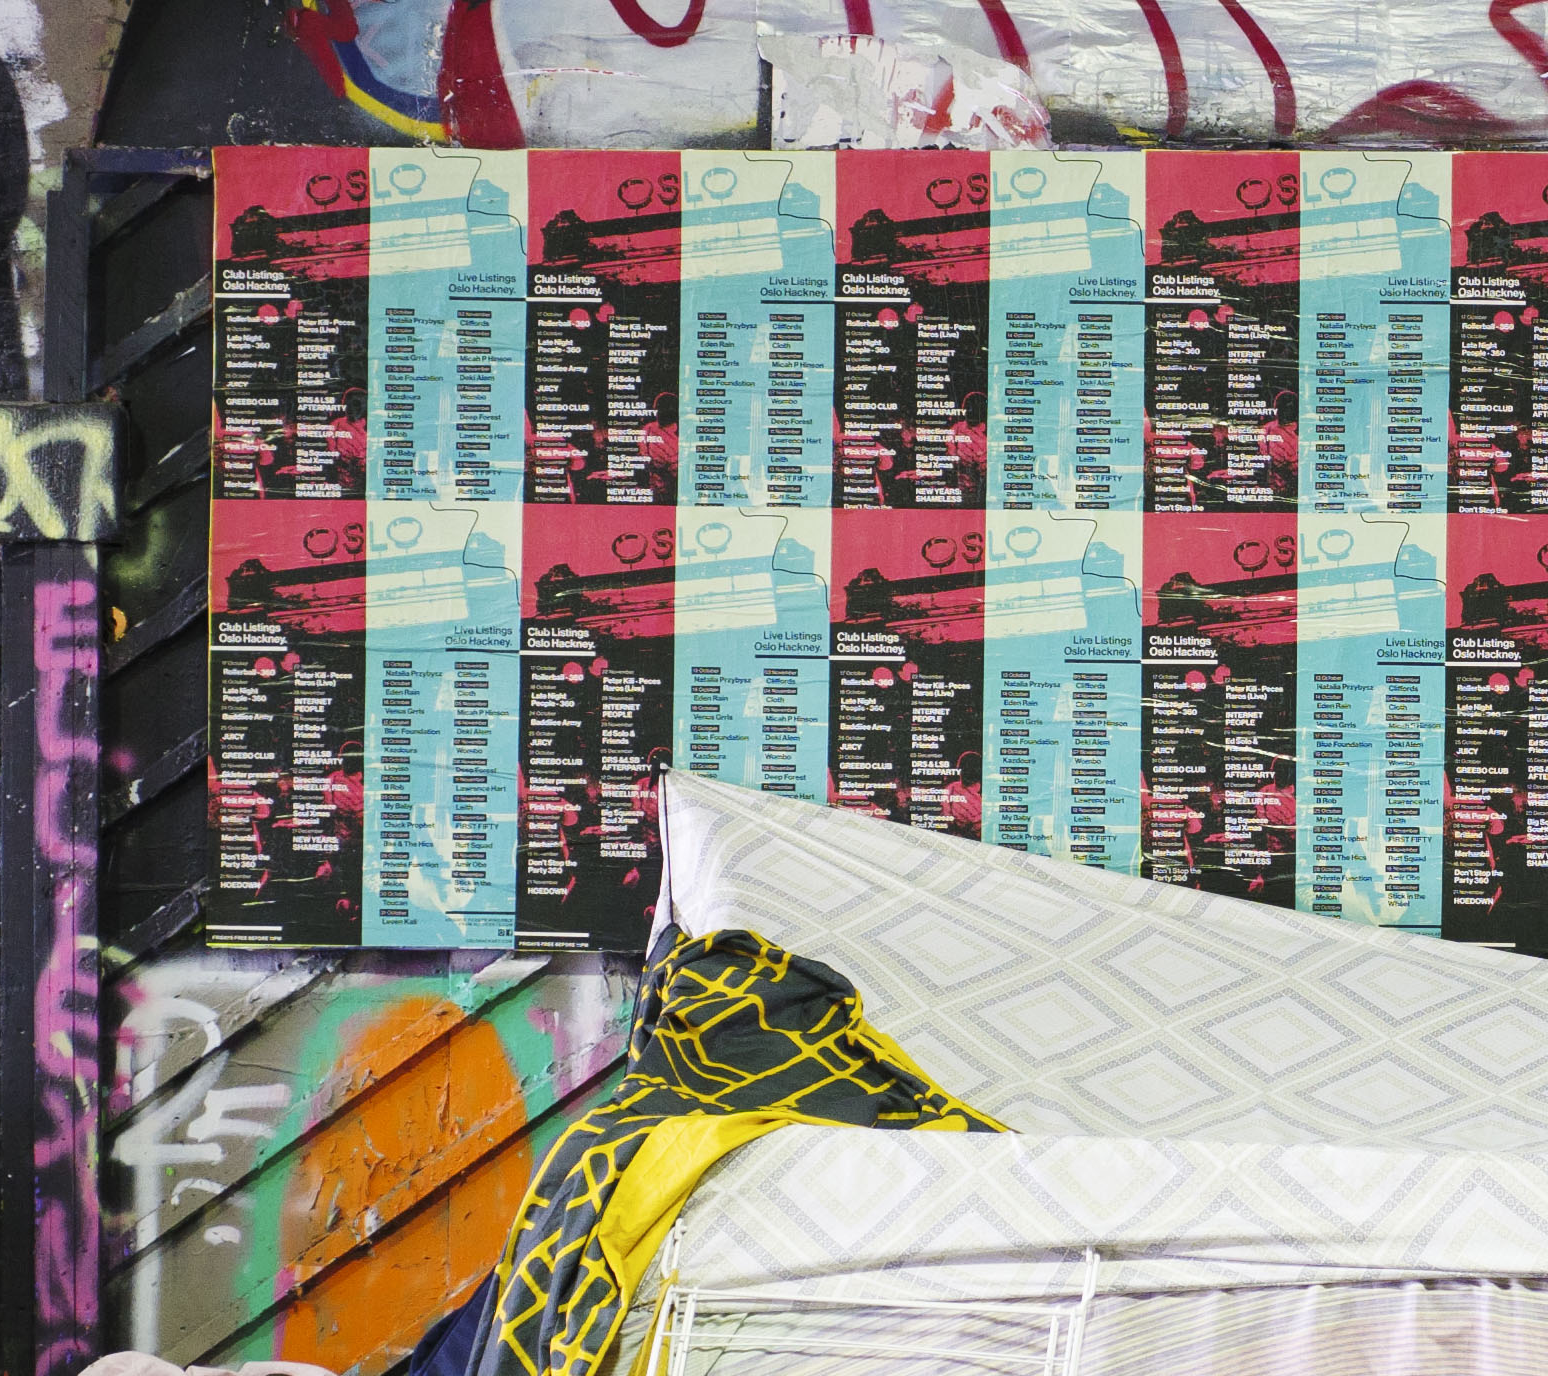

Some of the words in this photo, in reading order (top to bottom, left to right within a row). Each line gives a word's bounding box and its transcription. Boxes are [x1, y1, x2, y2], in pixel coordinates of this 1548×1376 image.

[306, 163, 426, 206] OSLO
[617, 167, 737, 209] OSLO
[926, 167, 1046, 209] OSLO
[1236, 167, 1356, 209] OSLO
[223, 270, 245, 280] Club
[247, 270, 284, 282] Listings
[458, 273, 476, 283] Live
[479, 274, 516, 285] Listings
[842, 274, 865, 284] Club
[866, 274, 904, 285] Listings
[1078, 277, 1098, 285] Live
[1100, 277, 1137, 287] Listings
[223, 281, 245, 291] Oslo
[246, 281, 290, 292] Hackney.
[1458, 277, 1481, 287] Club
[1482, 277, 1519, 289] Listings
[449, 284, 470, 294] Oslo
[472, 284, 516, 295] Hackney.
[842, 285, 865, 294] Oslo
[866, 285, 910, 296] Hackney.
[1069, 288, 1091, 297] Oslo
[1093, 288, 1137, 298] Hackney.
[1458, 288, 1481, 298] Oslo
[1482, 288, 1526, 299] Hackney.
[303, 516, 423, 558] OSLO
[611, 522, 732, 563] OSLO
[921, 526, 1042, 568] OSLO
[1234, 528, 1354, 572] OSLO
[837, 632, 859, 642] Club
[861, 632, 899, 644] Listings
[1072, 635, 1092, 645] Live
[1094, 636, 1132, 647] Listings
[837, 644, 860, 653] Oslo
[861, 644, 905, 655] Hackney.
[1064, 647, 1086, 656] Oslo
[1088, 647, 1132, 658] Hackney.
